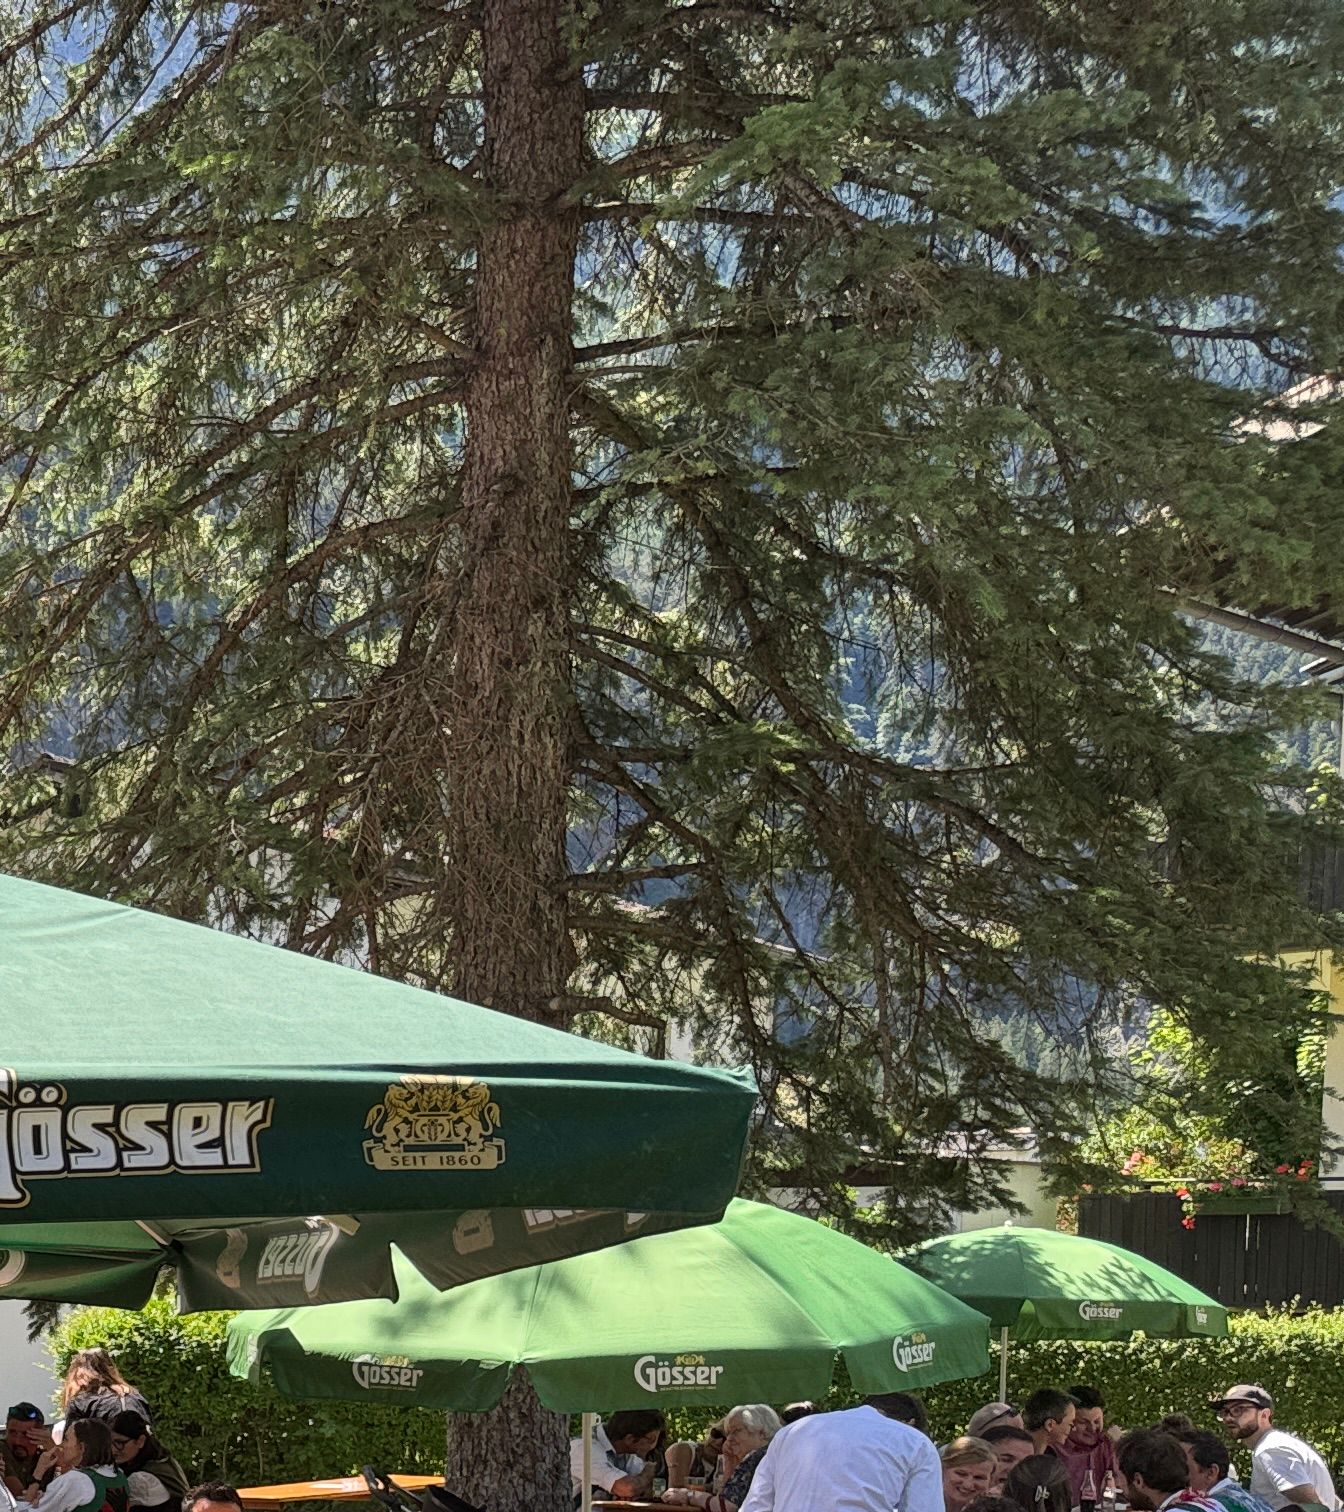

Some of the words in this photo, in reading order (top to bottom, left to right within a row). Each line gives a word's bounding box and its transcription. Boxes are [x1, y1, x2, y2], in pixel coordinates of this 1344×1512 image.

[390, 1155, 427, 1167] SEIT
[439, 1154, 481, 1166] 1860
[1079, 1301, 1123, 1321] Gösser
[893, 1336, 935, 1372] Gösser
[634, 1355, 724, 1392] Gösser
